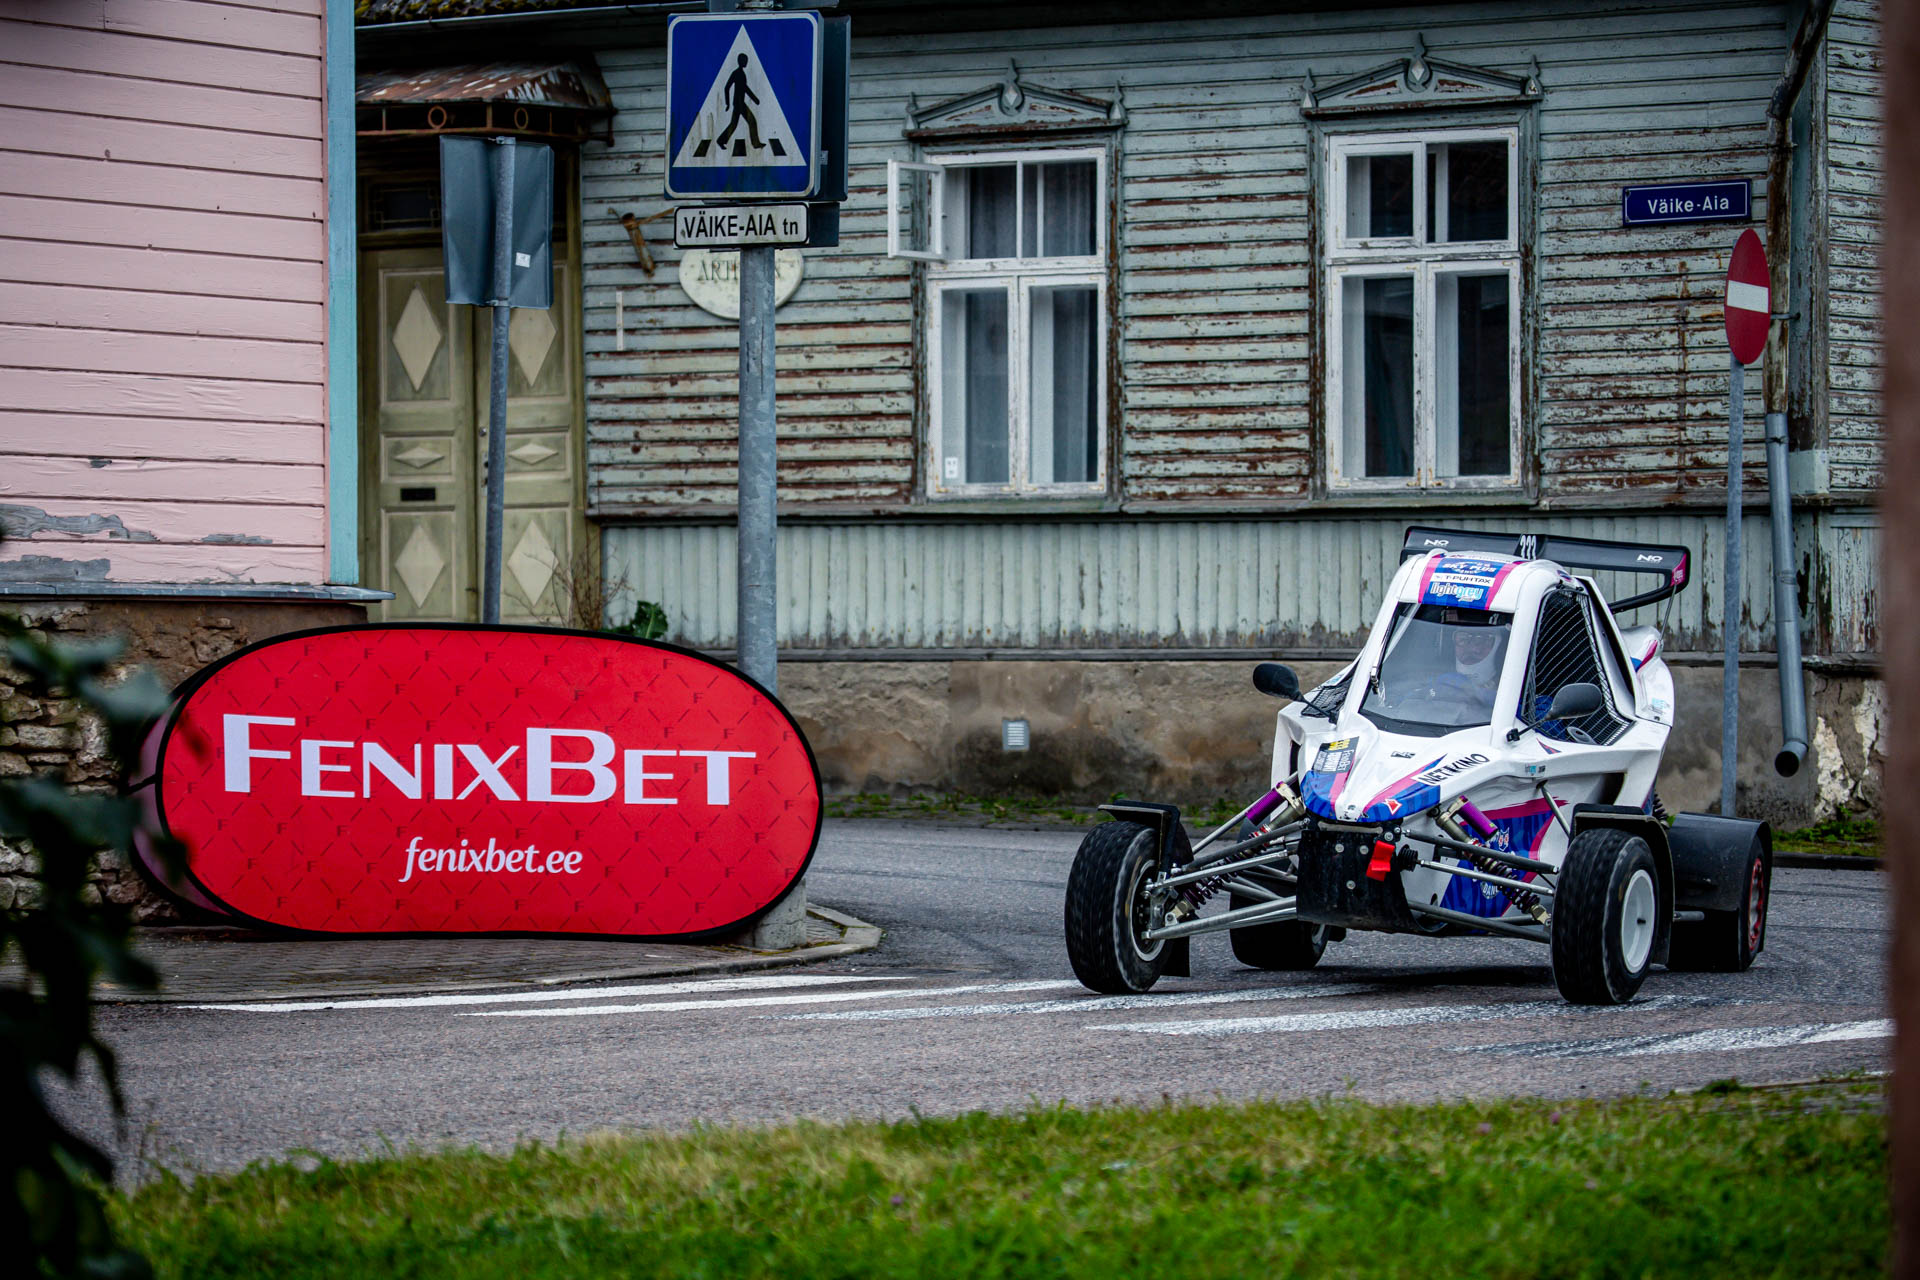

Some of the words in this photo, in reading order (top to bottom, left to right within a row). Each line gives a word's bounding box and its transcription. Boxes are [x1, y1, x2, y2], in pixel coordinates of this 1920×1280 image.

[684, 210, 777, 239] VÄIKE-AIA
[782, 217, 799, 236] tn
[398, 836, 584, 883] fenixbet.ee
